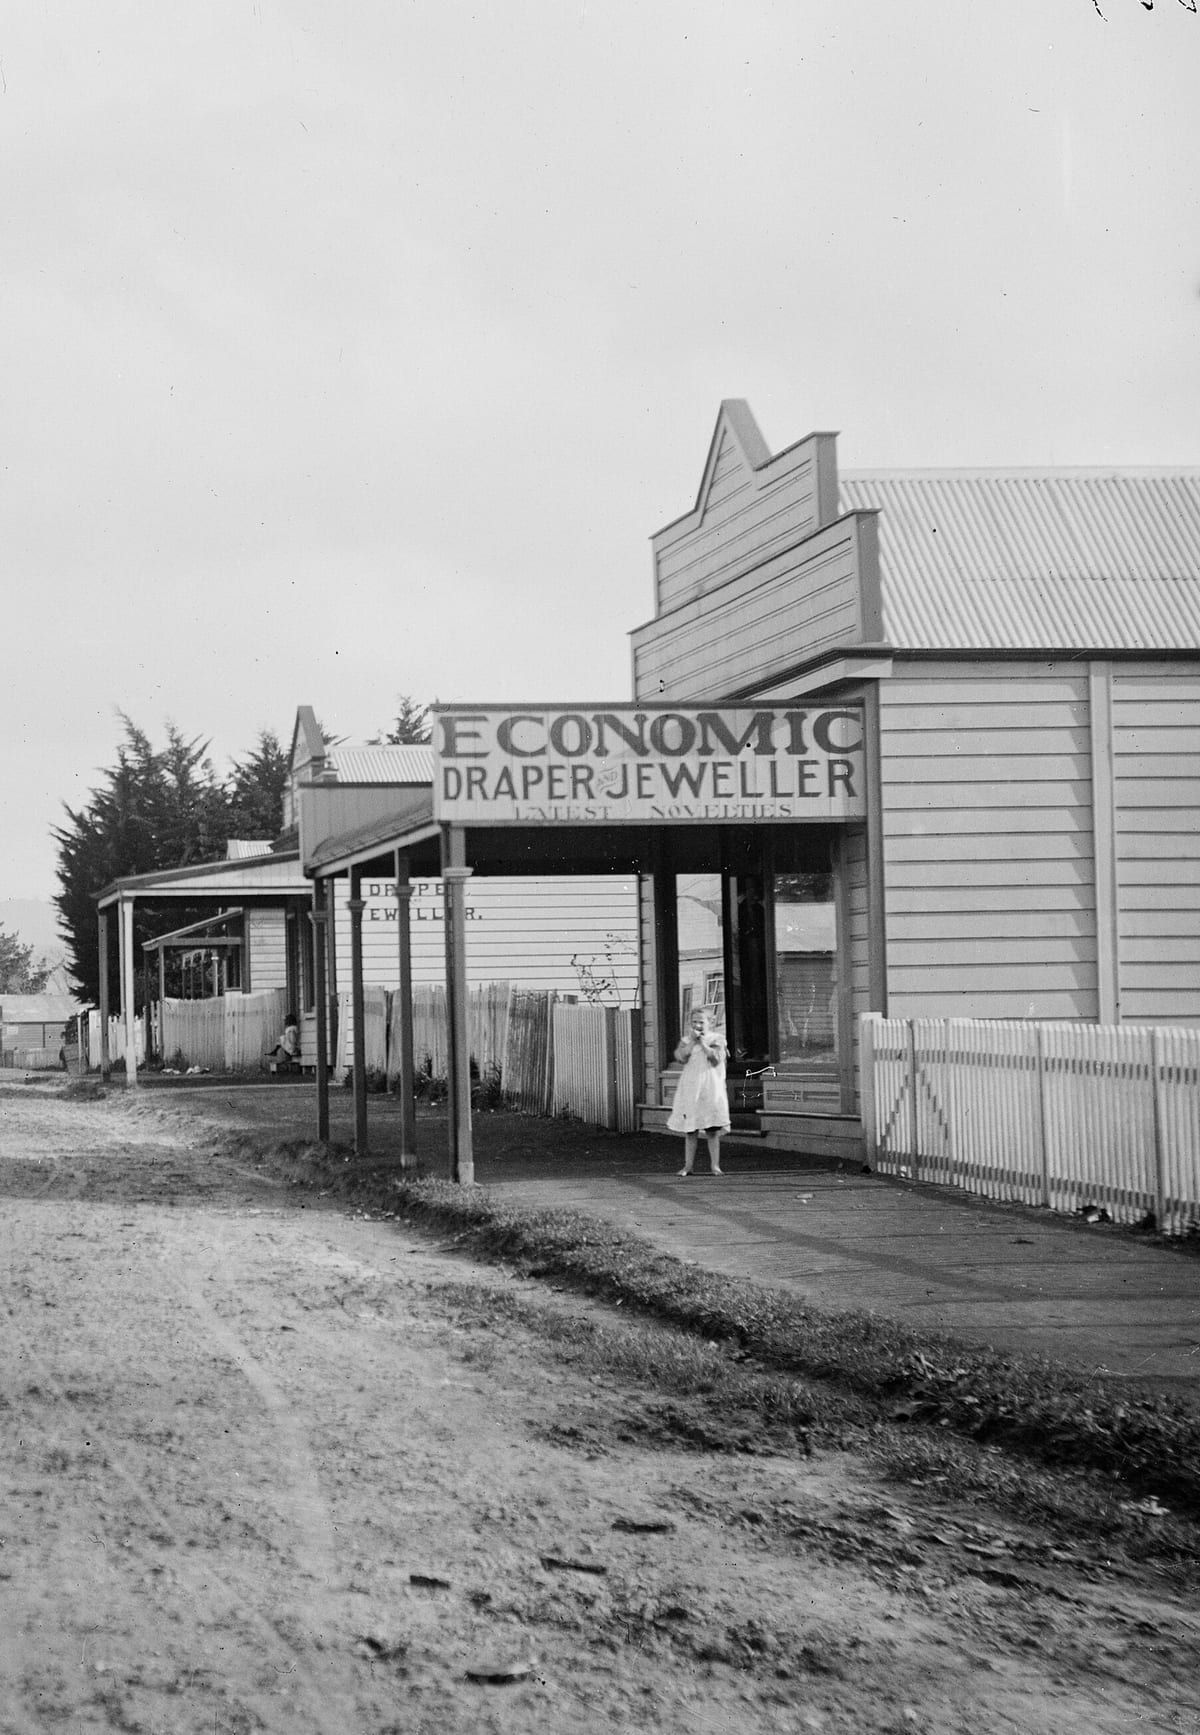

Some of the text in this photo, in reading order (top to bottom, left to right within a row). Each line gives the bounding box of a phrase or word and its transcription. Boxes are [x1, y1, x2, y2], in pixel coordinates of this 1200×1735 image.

[439, 711, 863, 758] ECONOMIC
[443, 764, 595, 800] DRAPER
[606, 759, 858, 799] JEWELLER
[651, 803, 792, 819] NOVELTIES
